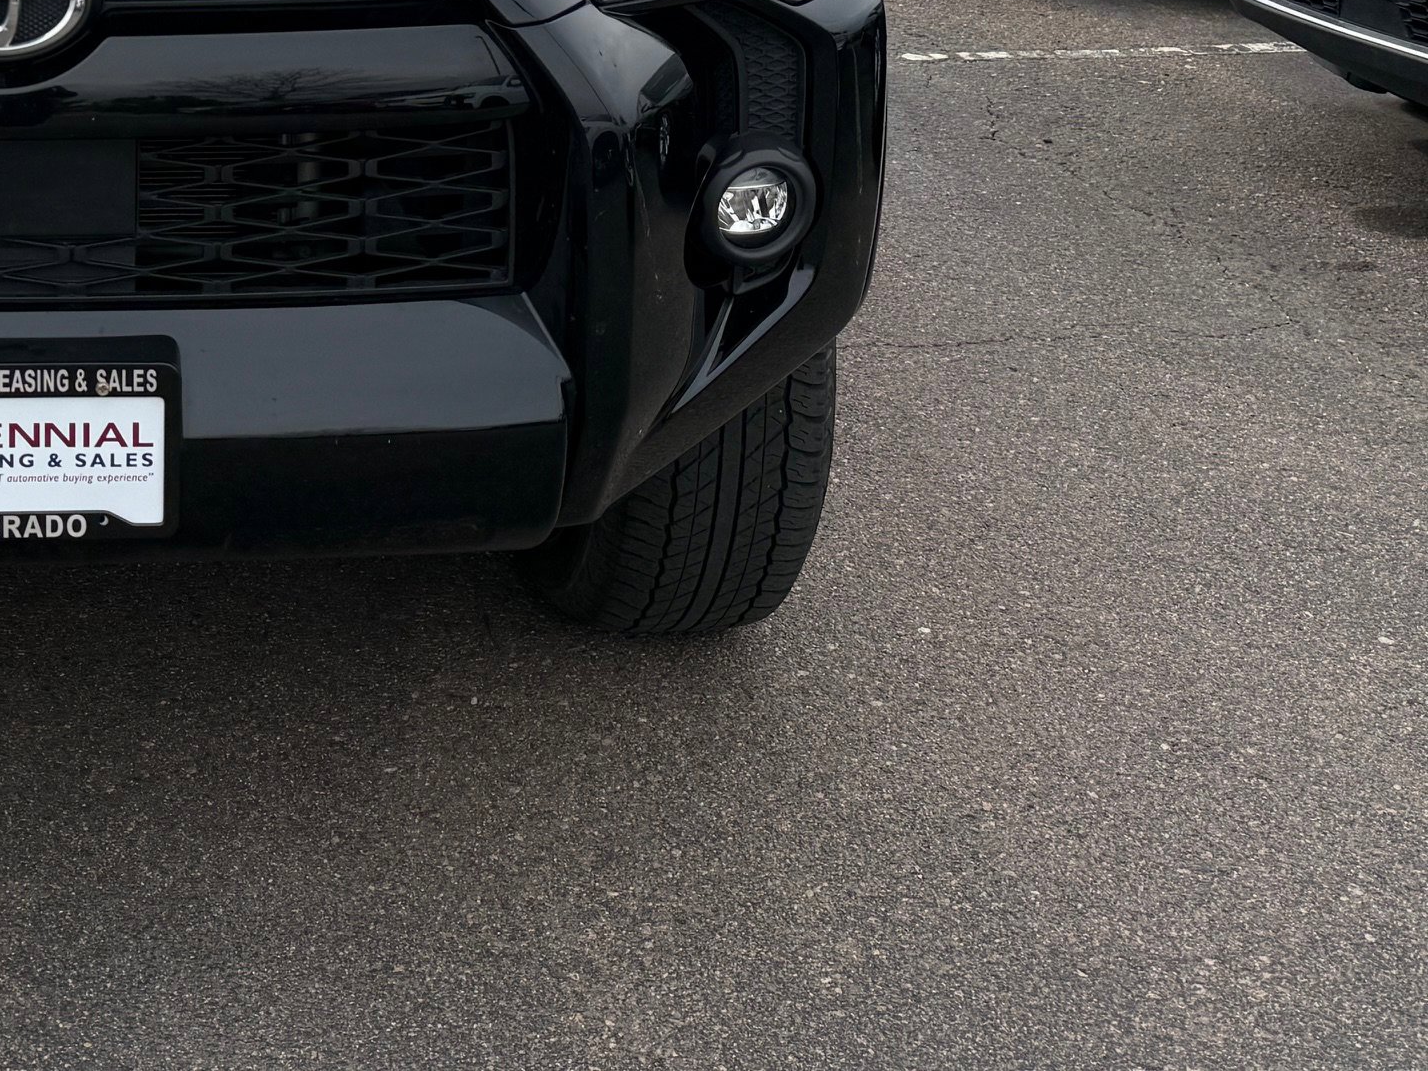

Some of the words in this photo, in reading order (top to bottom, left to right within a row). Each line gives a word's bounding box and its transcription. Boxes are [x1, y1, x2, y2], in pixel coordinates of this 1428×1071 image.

[75, 369, 88, 392] &
[96, 369, 158, 393] SALES
[47, 453, 62, 467] &
[75, 453, 154, 467] SALES
[6, 473, 59, 482] automotive
[62, 473, 93, 484] buying
[97, 472, 154, 483] experience"
